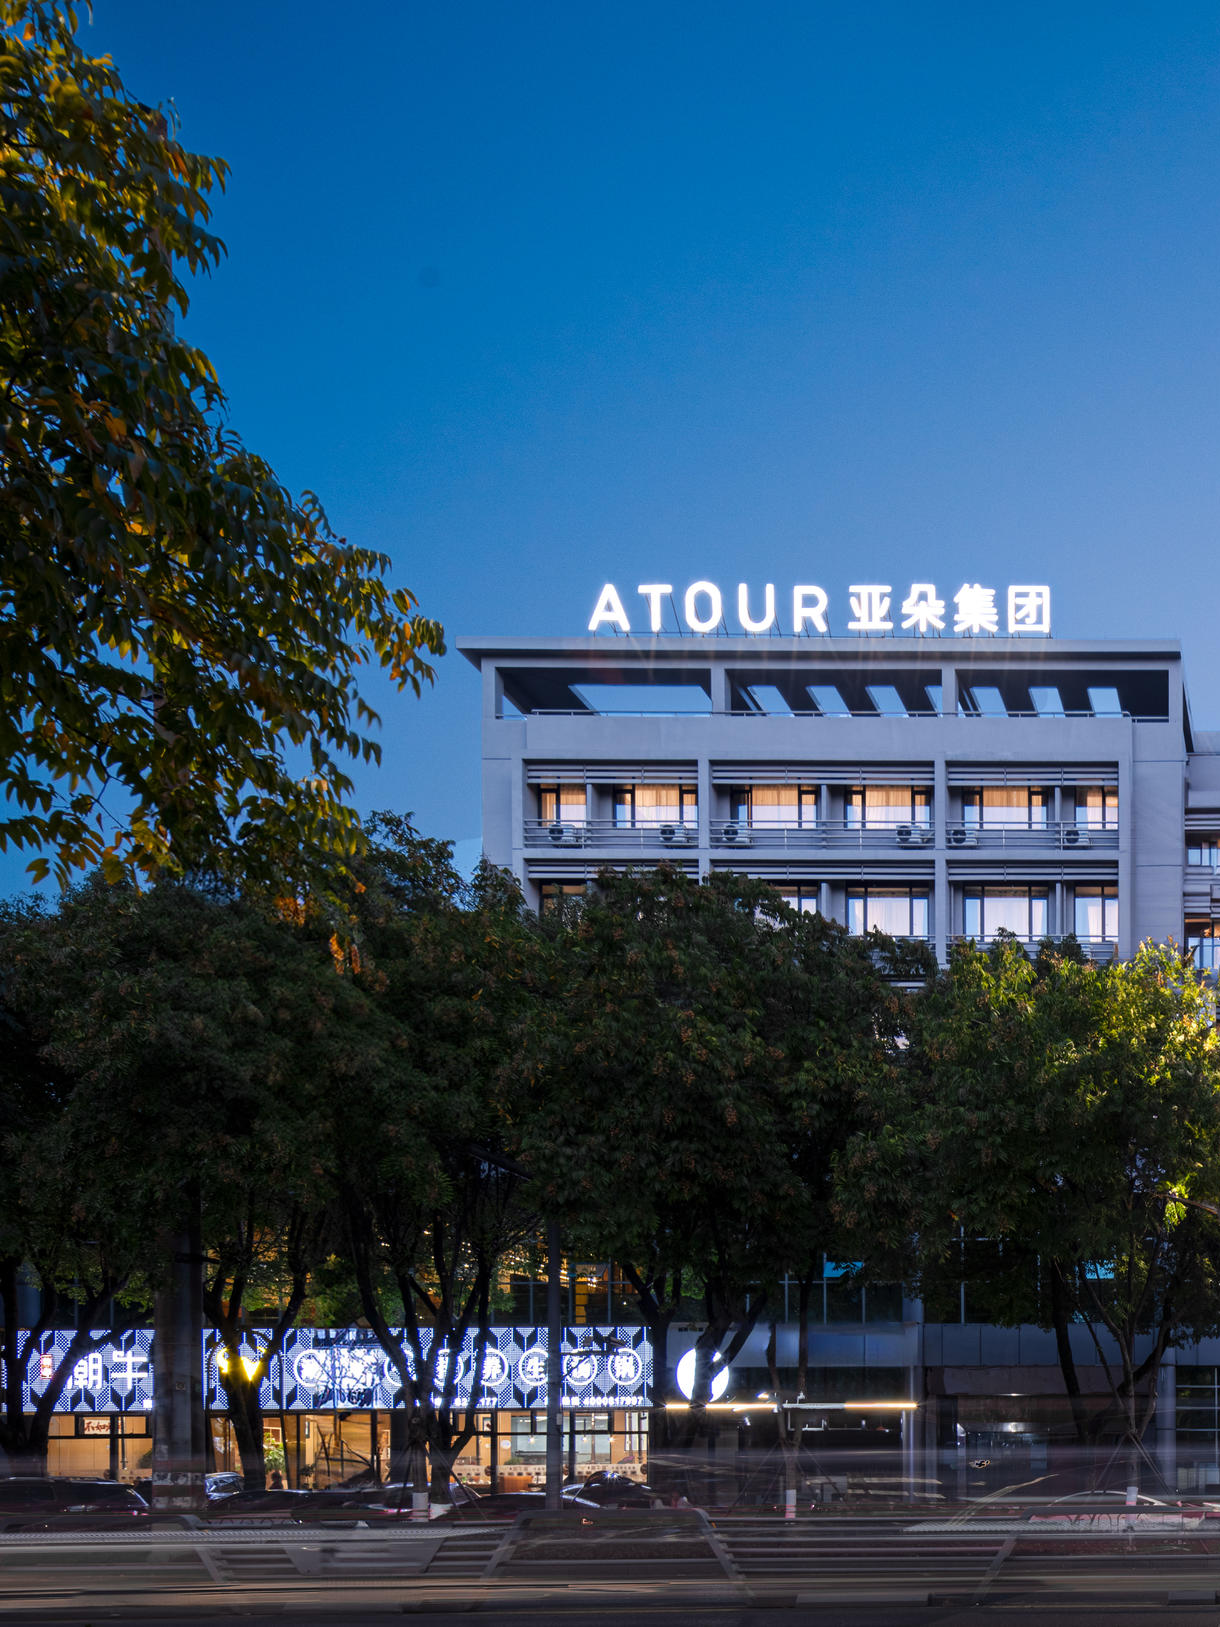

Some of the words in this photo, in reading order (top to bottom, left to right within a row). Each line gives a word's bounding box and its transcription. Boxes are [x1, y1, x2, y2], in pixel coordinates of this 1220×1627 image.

[588, 580, 829, 633] ATOUR
[847, 583, 1052, 633] 亚朵集团
